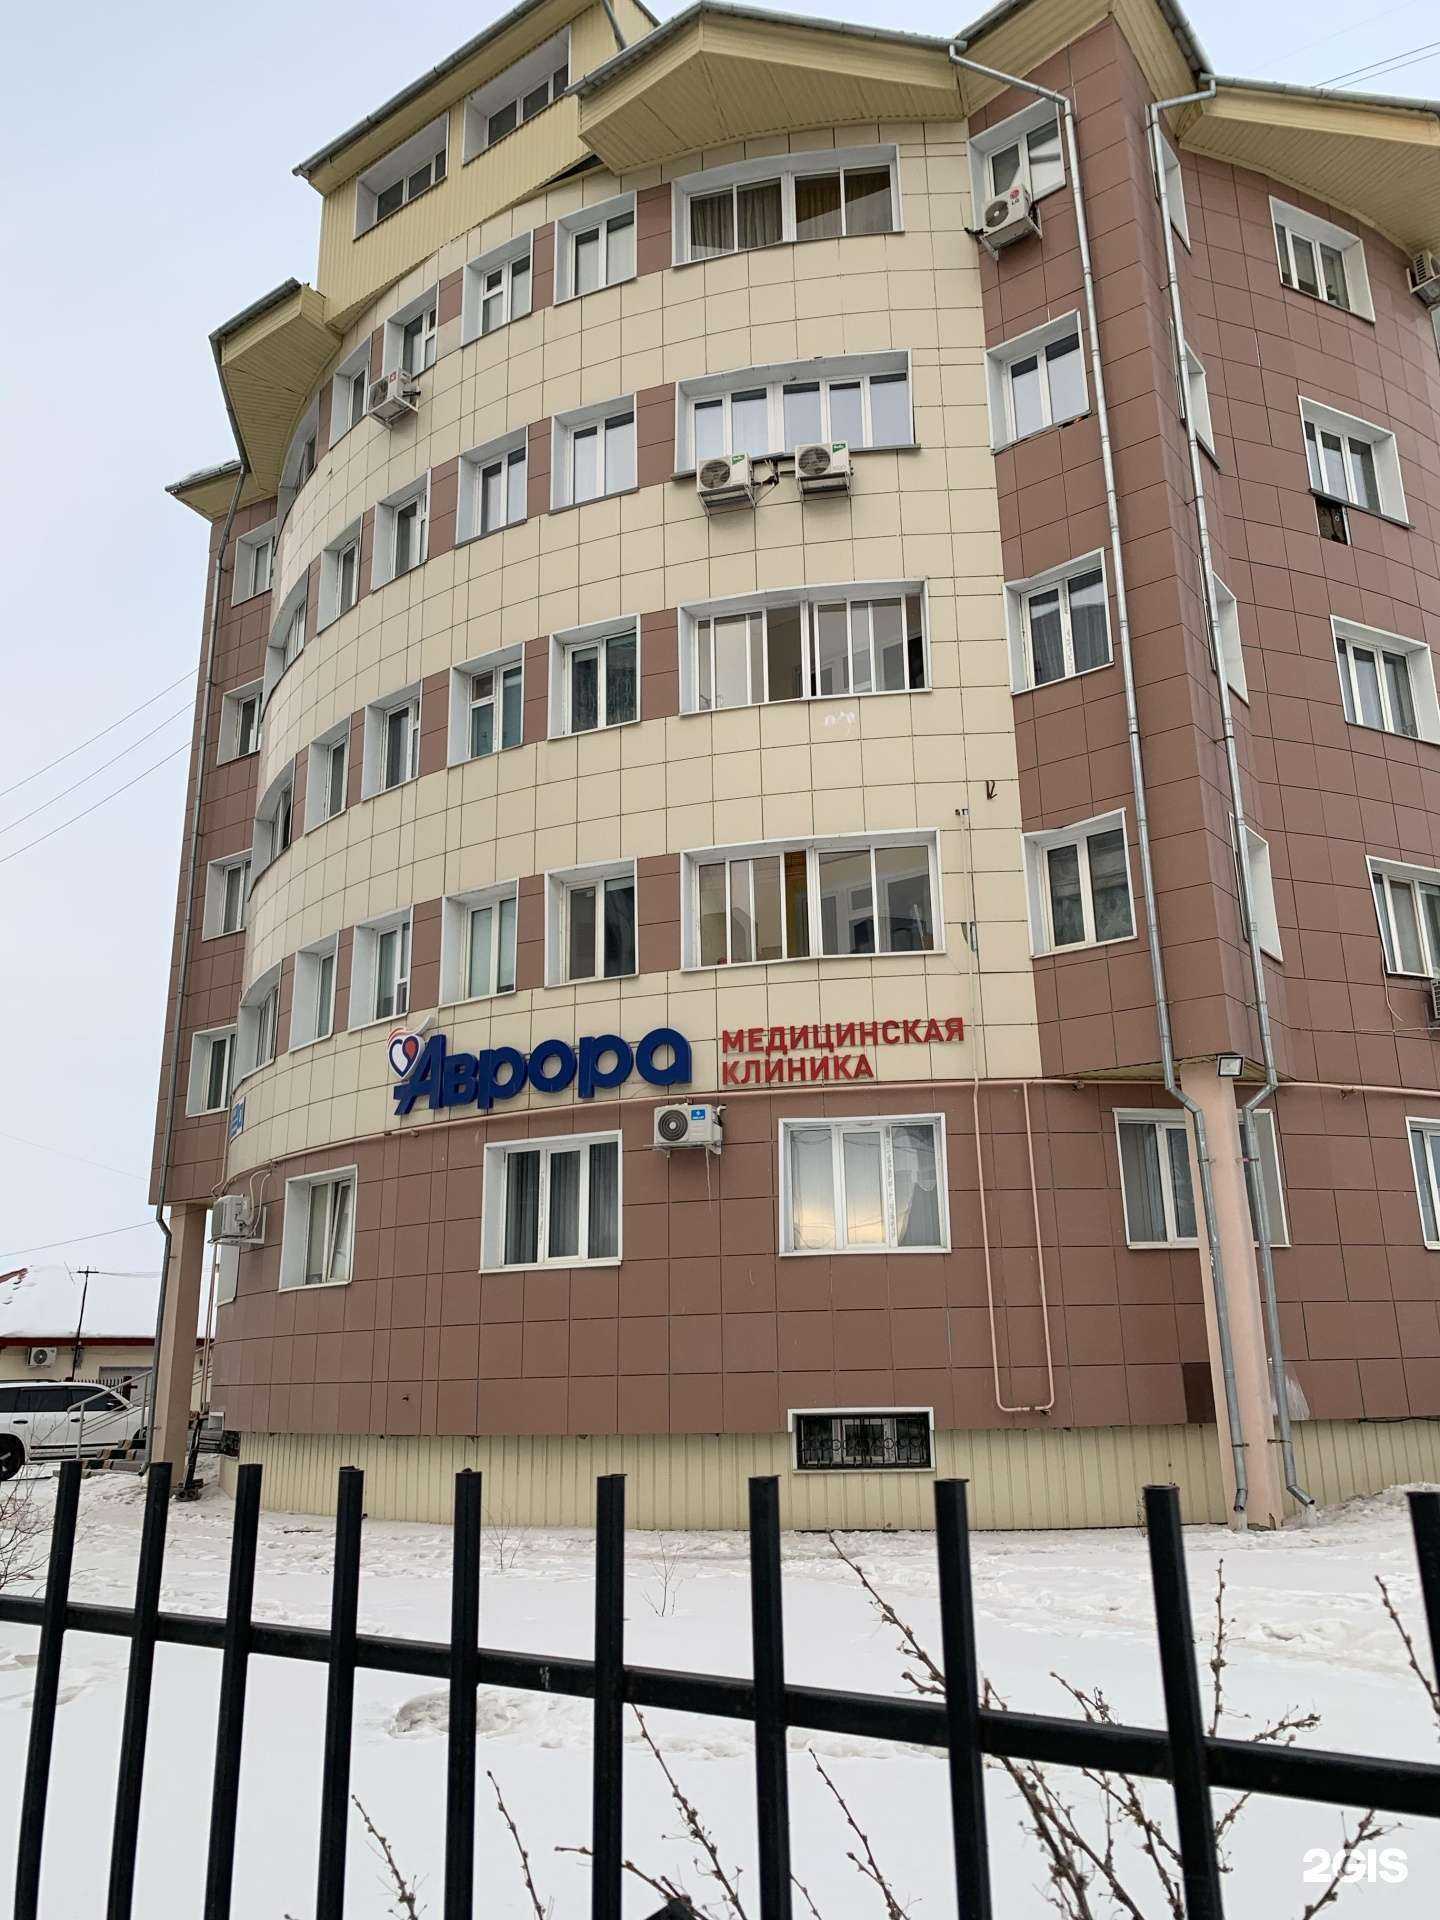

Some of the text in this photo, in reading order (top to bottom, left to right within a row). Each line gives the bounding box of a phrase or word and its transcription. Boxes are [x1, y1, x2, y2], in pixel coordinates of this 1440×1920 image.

[722, 1017, 964, 1055] МЕДИЦИНСКАЯ
[393, 1027, 692, 1115] Аврора
[722, 1054, 875, 1086] КЛИНИКА
